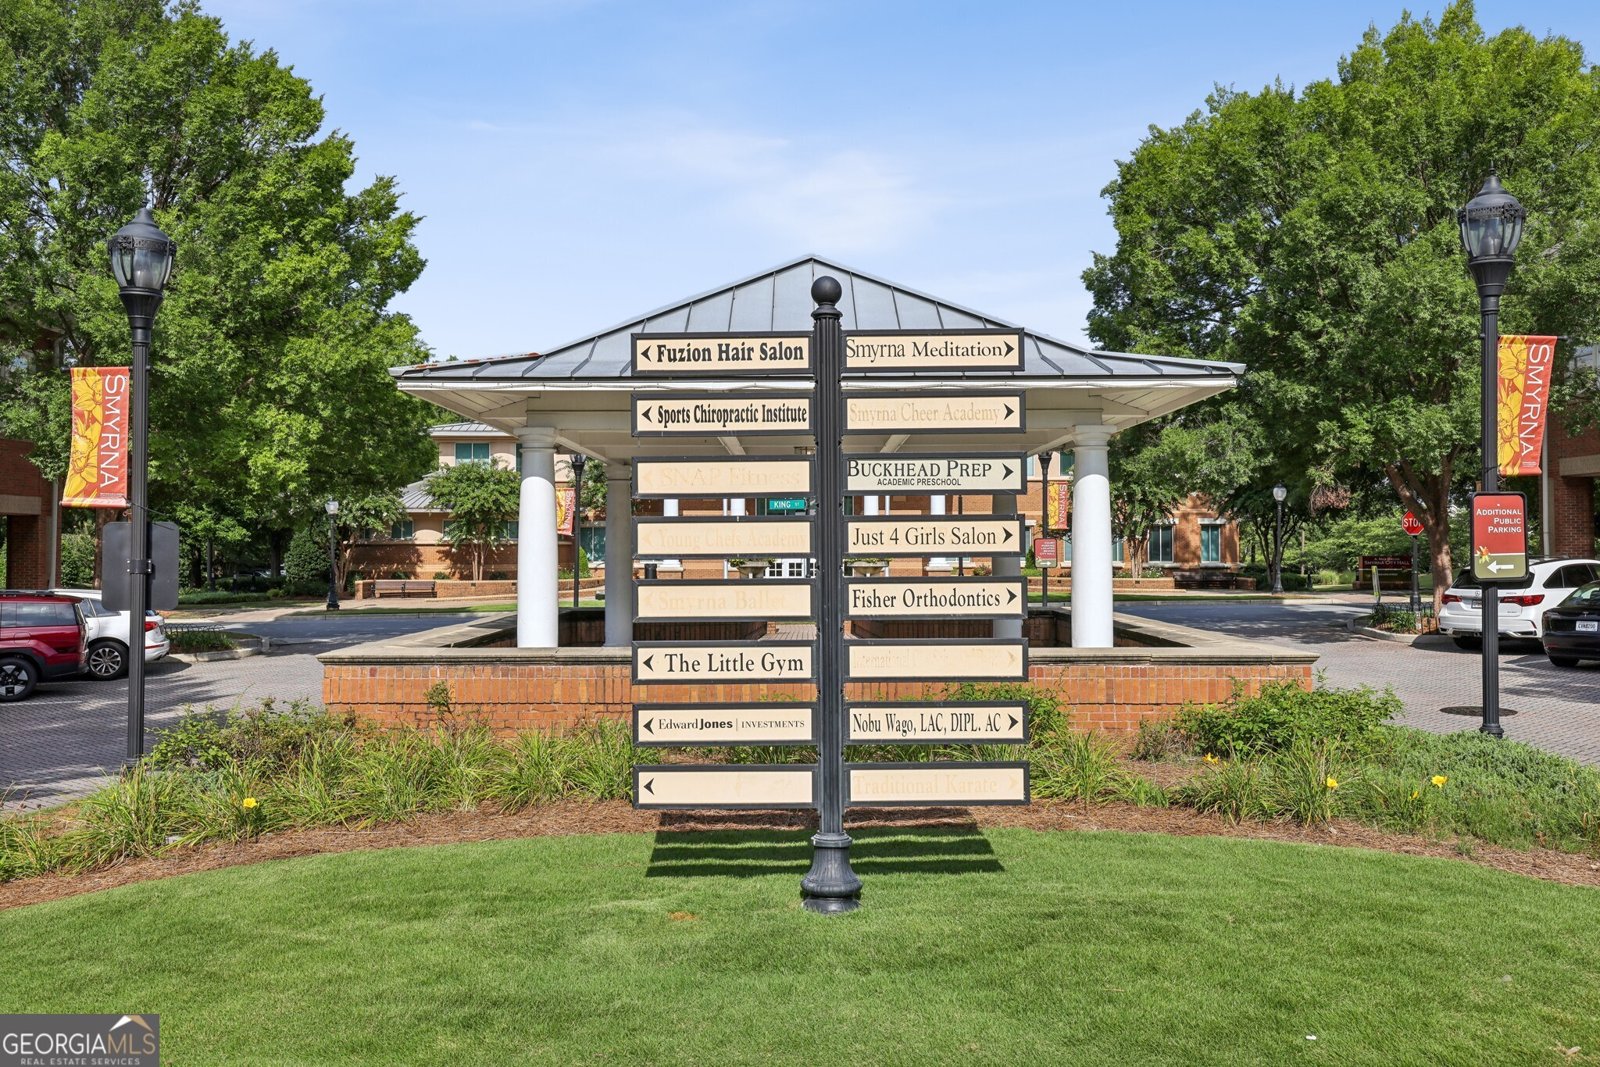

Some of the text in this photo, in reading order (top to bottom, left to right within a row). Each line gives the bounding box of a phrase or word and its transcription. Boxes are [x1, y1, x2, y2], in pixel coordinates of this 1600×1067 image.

[657, 341, 804, 363] Fuzion Hair Salon
[846, 339, 1003, 363] Smyrna Meditation
[1520, 344, 1550, 456] SMYRNA
[658, 403, 807, 428] Sports Chiropractic Institute
[850, 402, 999, 425] Smyrna Cheer Academy
[100, 374, 126, 488] SMYRNA
[848, 460, 992, 477] BUCKHEAD PREP
[917, 478, 961, 486] PRESCHOOL
[1059, 485, 1067, 523] SMYRNA
[1494, 517, 1522, 525] PUBLIC
[853, 526, 996, 546] Just 4 Girls Salon
[853, 587, 1001, 608] Fisher Orthodontics
[664, 653, 804, 676] The Little Gym
[741, 720, 805, 728] INVESTMENTS
[853, 713, 1001, 737] Nobu Wago, LAC, DIPL. AC
[853, 774, 997, 793] Traditional Karate
